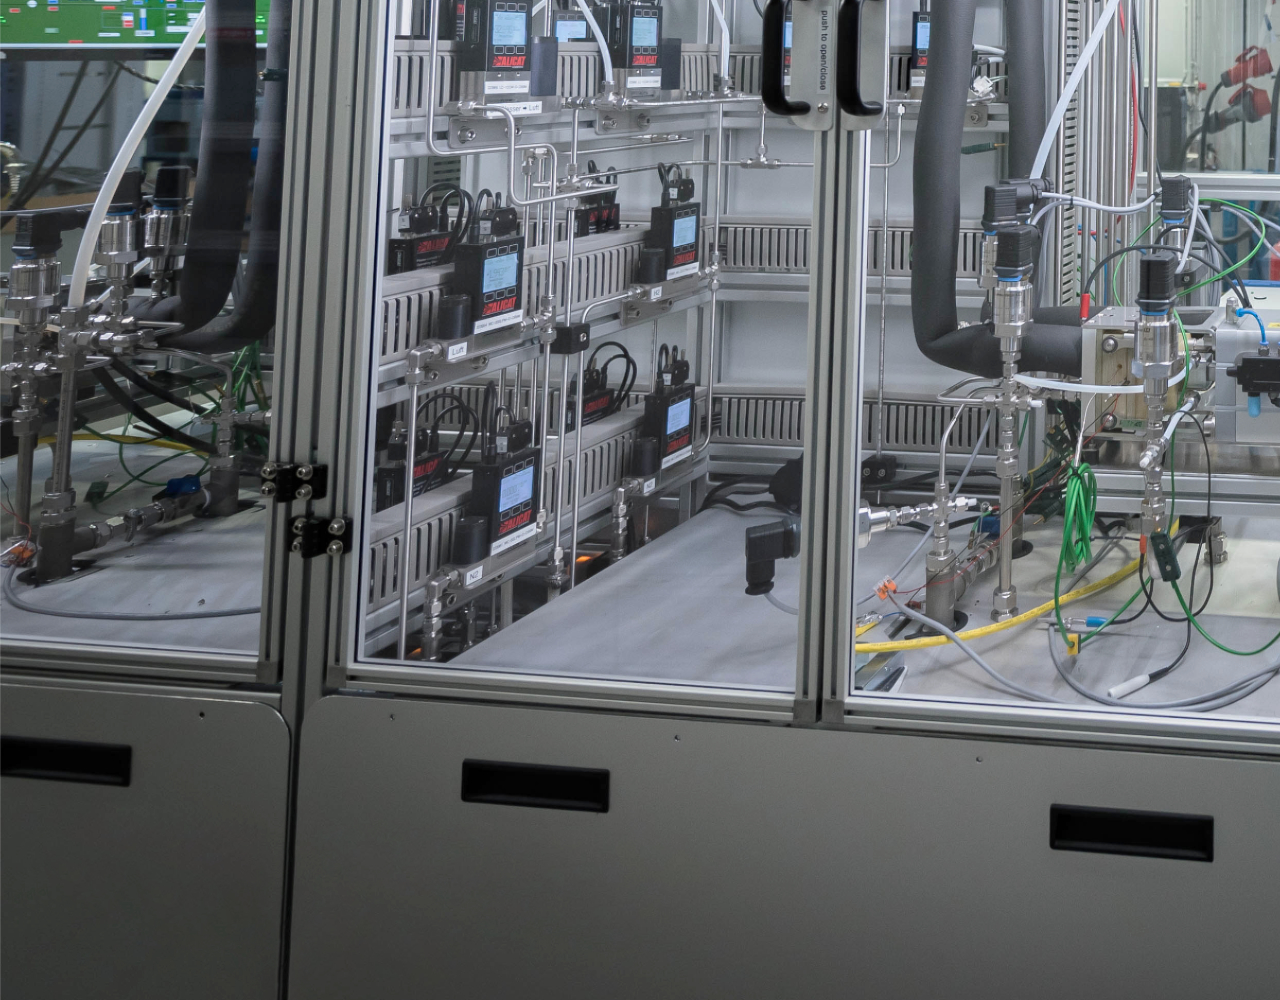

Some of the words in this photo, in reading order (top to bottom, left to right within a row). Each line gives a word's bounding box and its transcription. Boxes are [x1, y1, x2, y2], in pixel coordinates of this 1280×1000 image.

[821, 10, 829, 31] push
[821, 33, 828, 41] to
[500, 56, 526, 67] ALICAT
[820, 44, 828, 90] open/close
[529, 104, 540, 112] Luft
[489, 296, 517, 313] ALICAT
[452, 344, 464, 356] Luft
[504, 509, 532, 530] ALICAT
[469, 569, 480, 580] N2
